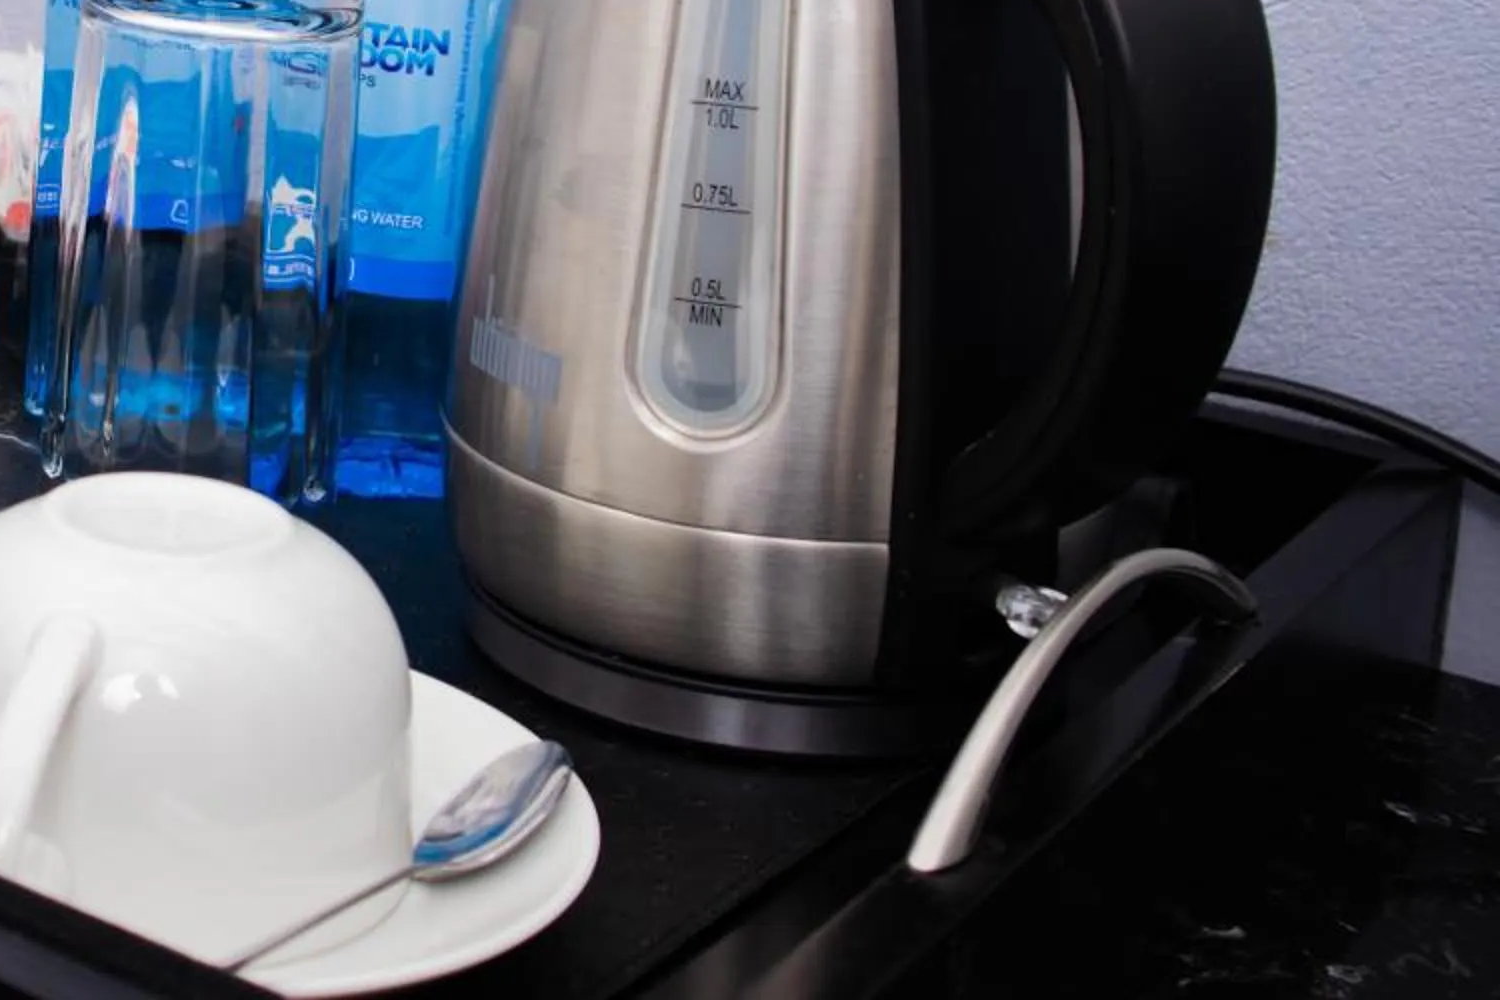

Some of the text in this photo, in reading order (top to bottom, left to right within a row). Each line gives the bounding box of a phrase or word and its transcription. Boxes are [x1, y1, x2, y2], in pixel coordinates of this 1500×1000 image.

[705, 77, 746, 101] MAX
[706, 108, 740, 129] 1.0L
[693, 182, 739, 206] 0.75L
[370, 210, 424, 230] WATER
[692, 277, 725, 300] 0.5L
[689, 304, 723, 328] MIN
